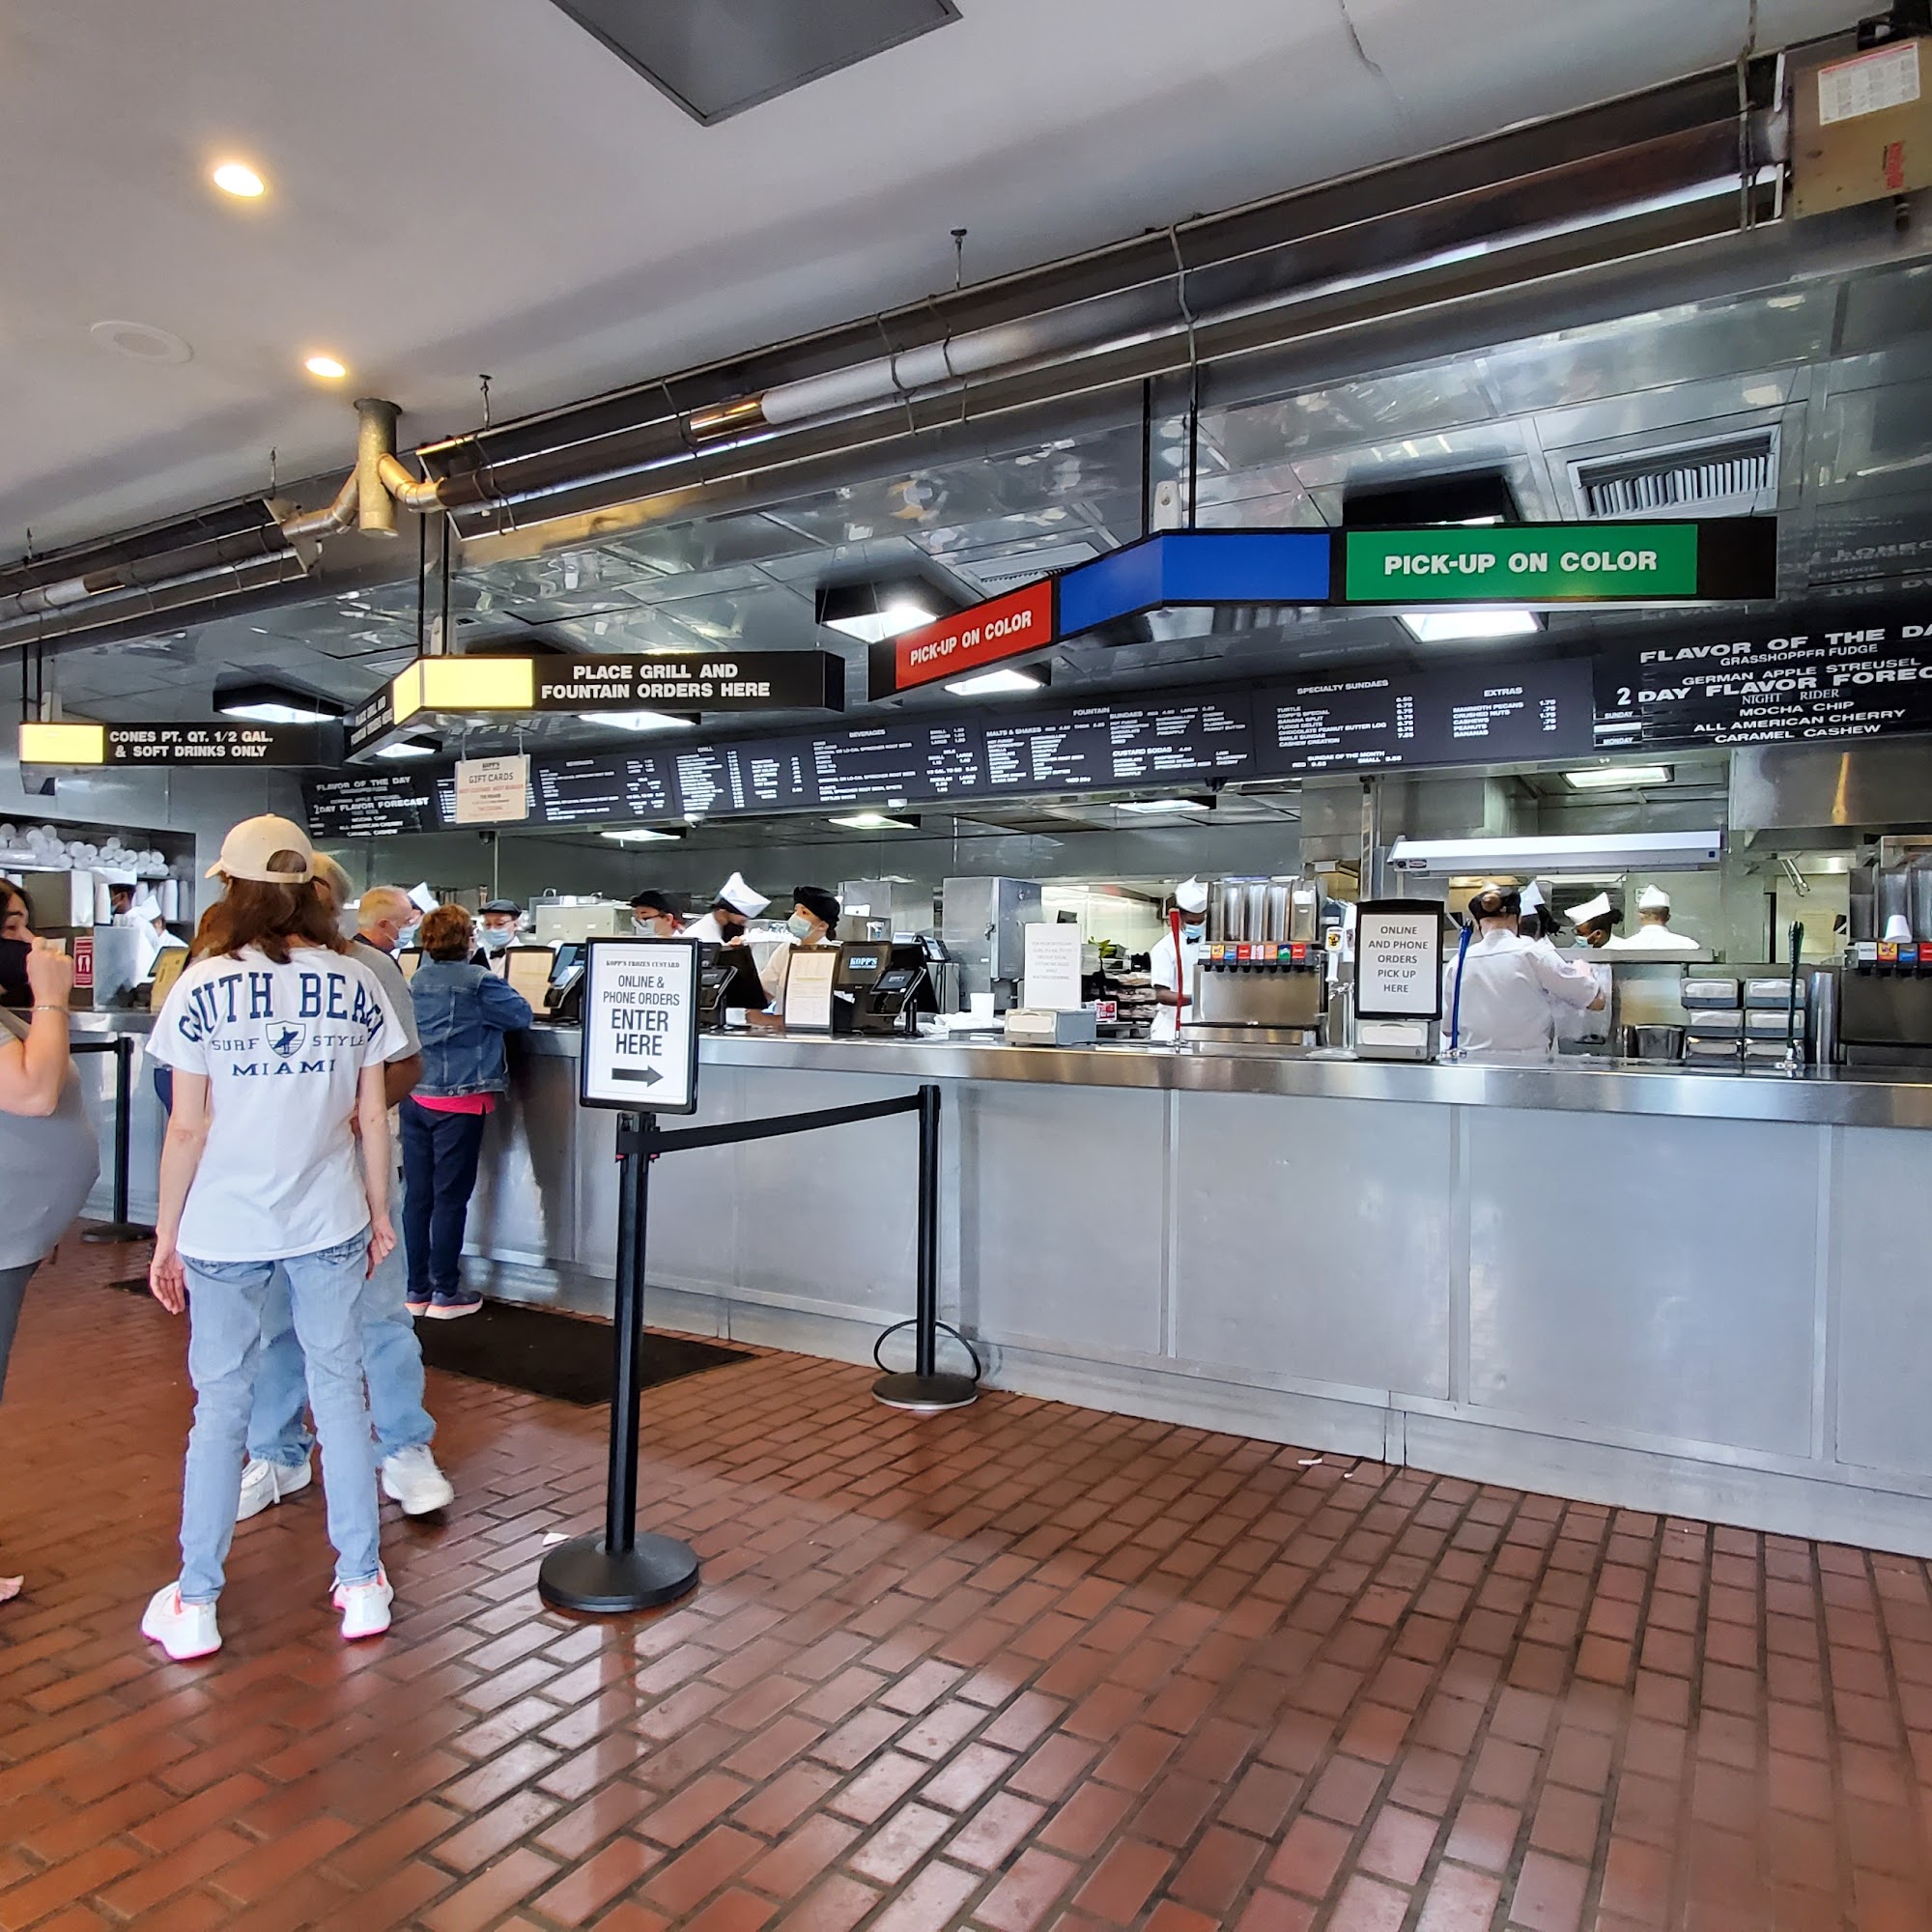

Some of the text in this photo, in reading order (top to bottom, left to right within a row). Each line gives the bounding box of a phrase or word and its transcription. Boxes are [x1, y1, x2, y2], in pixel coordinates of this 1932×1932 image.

[1384, 551, 1658, 575] PICK-UP ON COLOR
[910, 610, 1032, 666] PICK-UP ON COLOR
[1640, 642, 1751, 664] FLAVOR
[1767, 636, 1809, 651] OF
[1825, 628, 1886, 645] THE
[1829, 644, 1878, 656] FUDGE
[573, 664, 739, 679] PLACE GRILL AND
[1682, 658, 1922, 685] GERMAN APPLE STREUSEL
[541, 682, 770, 699] FOUNTAIN ORDERS HERE
[1296, 680, 1389, 695] SPECIALTY SUNDAES
[1483, 687, 1523, 697] EXTRAS
[1616, 687, 1632, 706] 2
[1637, 687, 1691, 703] DAY
[1705, 677, 1818, 697] FLAVOR
[1742, 689, 1840, 705] NIGHT RIDER
[1073, 707, 1110, 716] FOUNTAIN
[1109, 711, 1143, 719] SUNDAES
[1452, 705, 1492, 713] MAMMOTH
[1604, 711, 1634, 719] SUNDAY
[1739, 701, 1855, 717] MOCHA CHIP
[1693, 709, 1906, 733] ALL AMERICAN CHERRY
[110, 731, 274, 742] CONES PT. QT. 1/2 GAL.
[1279, 728, 1317, 736] CHOCOLATE
[1714, 724, 1881, 743] CARAMEL CASHEW
[115, 745, 267, 758] & SOFT DRINKS ONLY
[1112, 748, 1146, 757] CUSTARD
[316, 782, 350, 792] FLAVOR
[392, 776, 411, 784] DAY
[469, 772, 513, 784] GIFT CARDS
[340, 802, 375, 812] FLAVOR
[378, 796, 430, 809] FORECAST
[1380, 926, 1418, 935] ONLINE
[1368, 940, 1428, 949] AND PHONE
[850, 957, 878, 965] KOPP'S
[1378, 955, 1418, 964] ORDERS
[1378, 969, 1416, 978] PICK UP
[618, 975, 665, 988] ONLINE &
[1384, 984, 1409, 992] HERE
[603, 991, 680, 1006] PHONE ORDERS
[611, 1008, 669, 1032] ENTER
[211, 1035, 365, 1052] SURF STYLE
[615, 1033, 663, 1056] HERE
[232, 1058, 335, 1076] MIAMI
